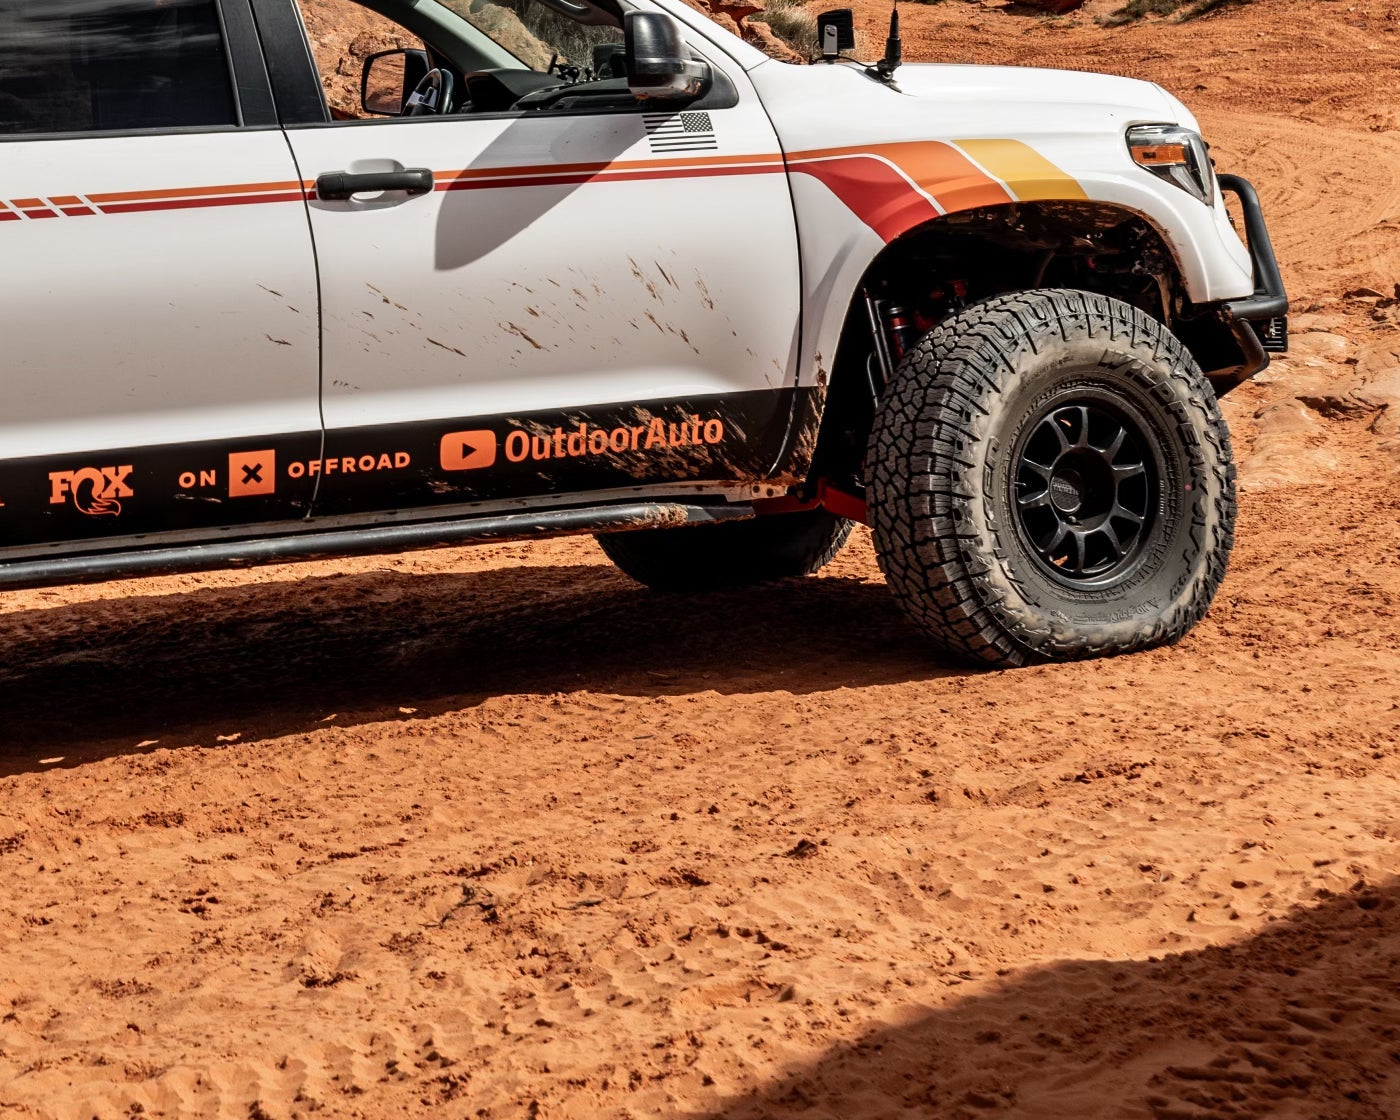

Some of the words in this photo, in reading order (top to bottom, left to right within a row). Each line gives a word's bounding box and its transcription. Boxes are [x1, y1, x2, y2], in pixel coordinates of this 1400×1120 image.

[505, 414, 724, 463] OutdoorAuto
[48, 464, 134, 515] FOX
[178, 469, 216, 489] ON
[288, 452, 411, 479] OFFROAD
